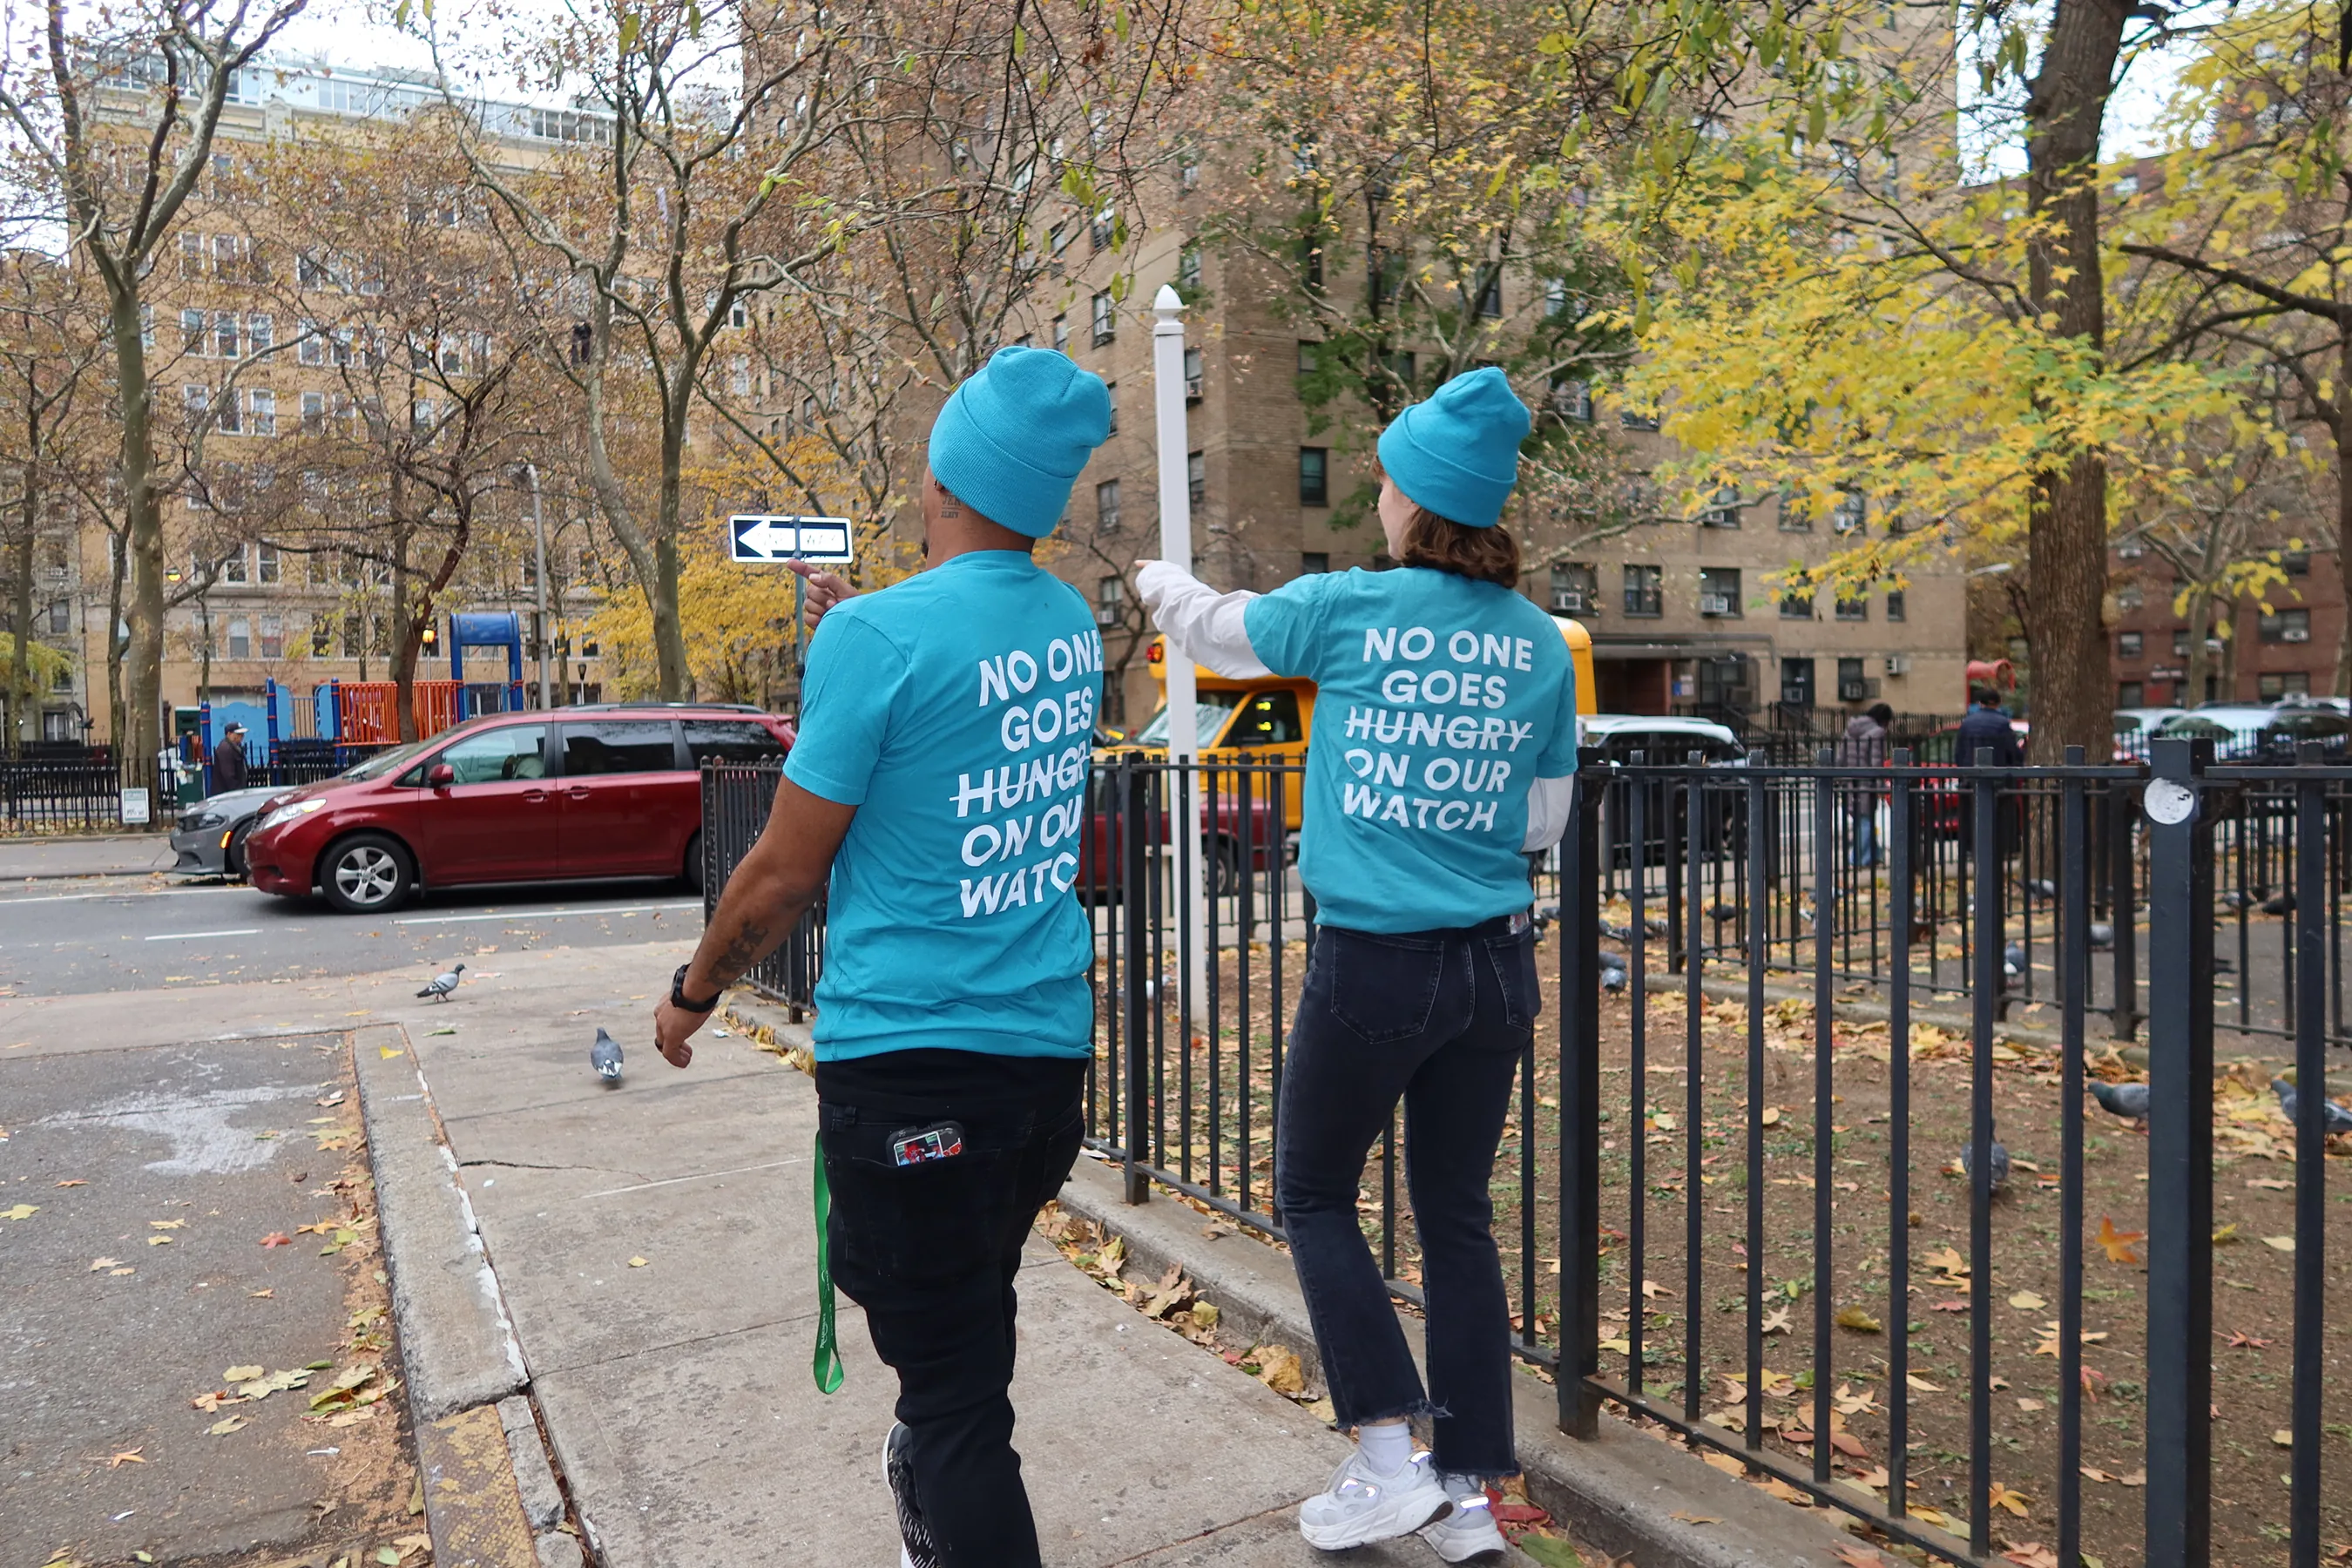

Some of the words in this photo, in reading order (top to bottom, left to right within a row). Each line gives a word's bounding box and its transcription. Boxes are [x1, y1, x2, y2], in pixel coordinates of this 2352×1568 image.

[978, 650, 1038, 707] NO
[1047, 629, 1104, 683] ONE
[1362, 626, 1436, 662] NO
[1448, 630, 1534, 672] ONE
[1382, 669, 1507, 709] GOES
[1002, 686, 1093, 753] GOES
[1345, 706, 1533, 753] HUNGRY
[956, 738, 1092, 818] HUNGR
[1344, 748, 1411, 788] ON
[1423, 757, 1511, 794] OUR
[961, 814, 1033, 868] ON
[1040, 794, 1083, 848] OU
[1343, 783, 1498, 832] WATCH
[959, 845, 1081, 918] WATC
